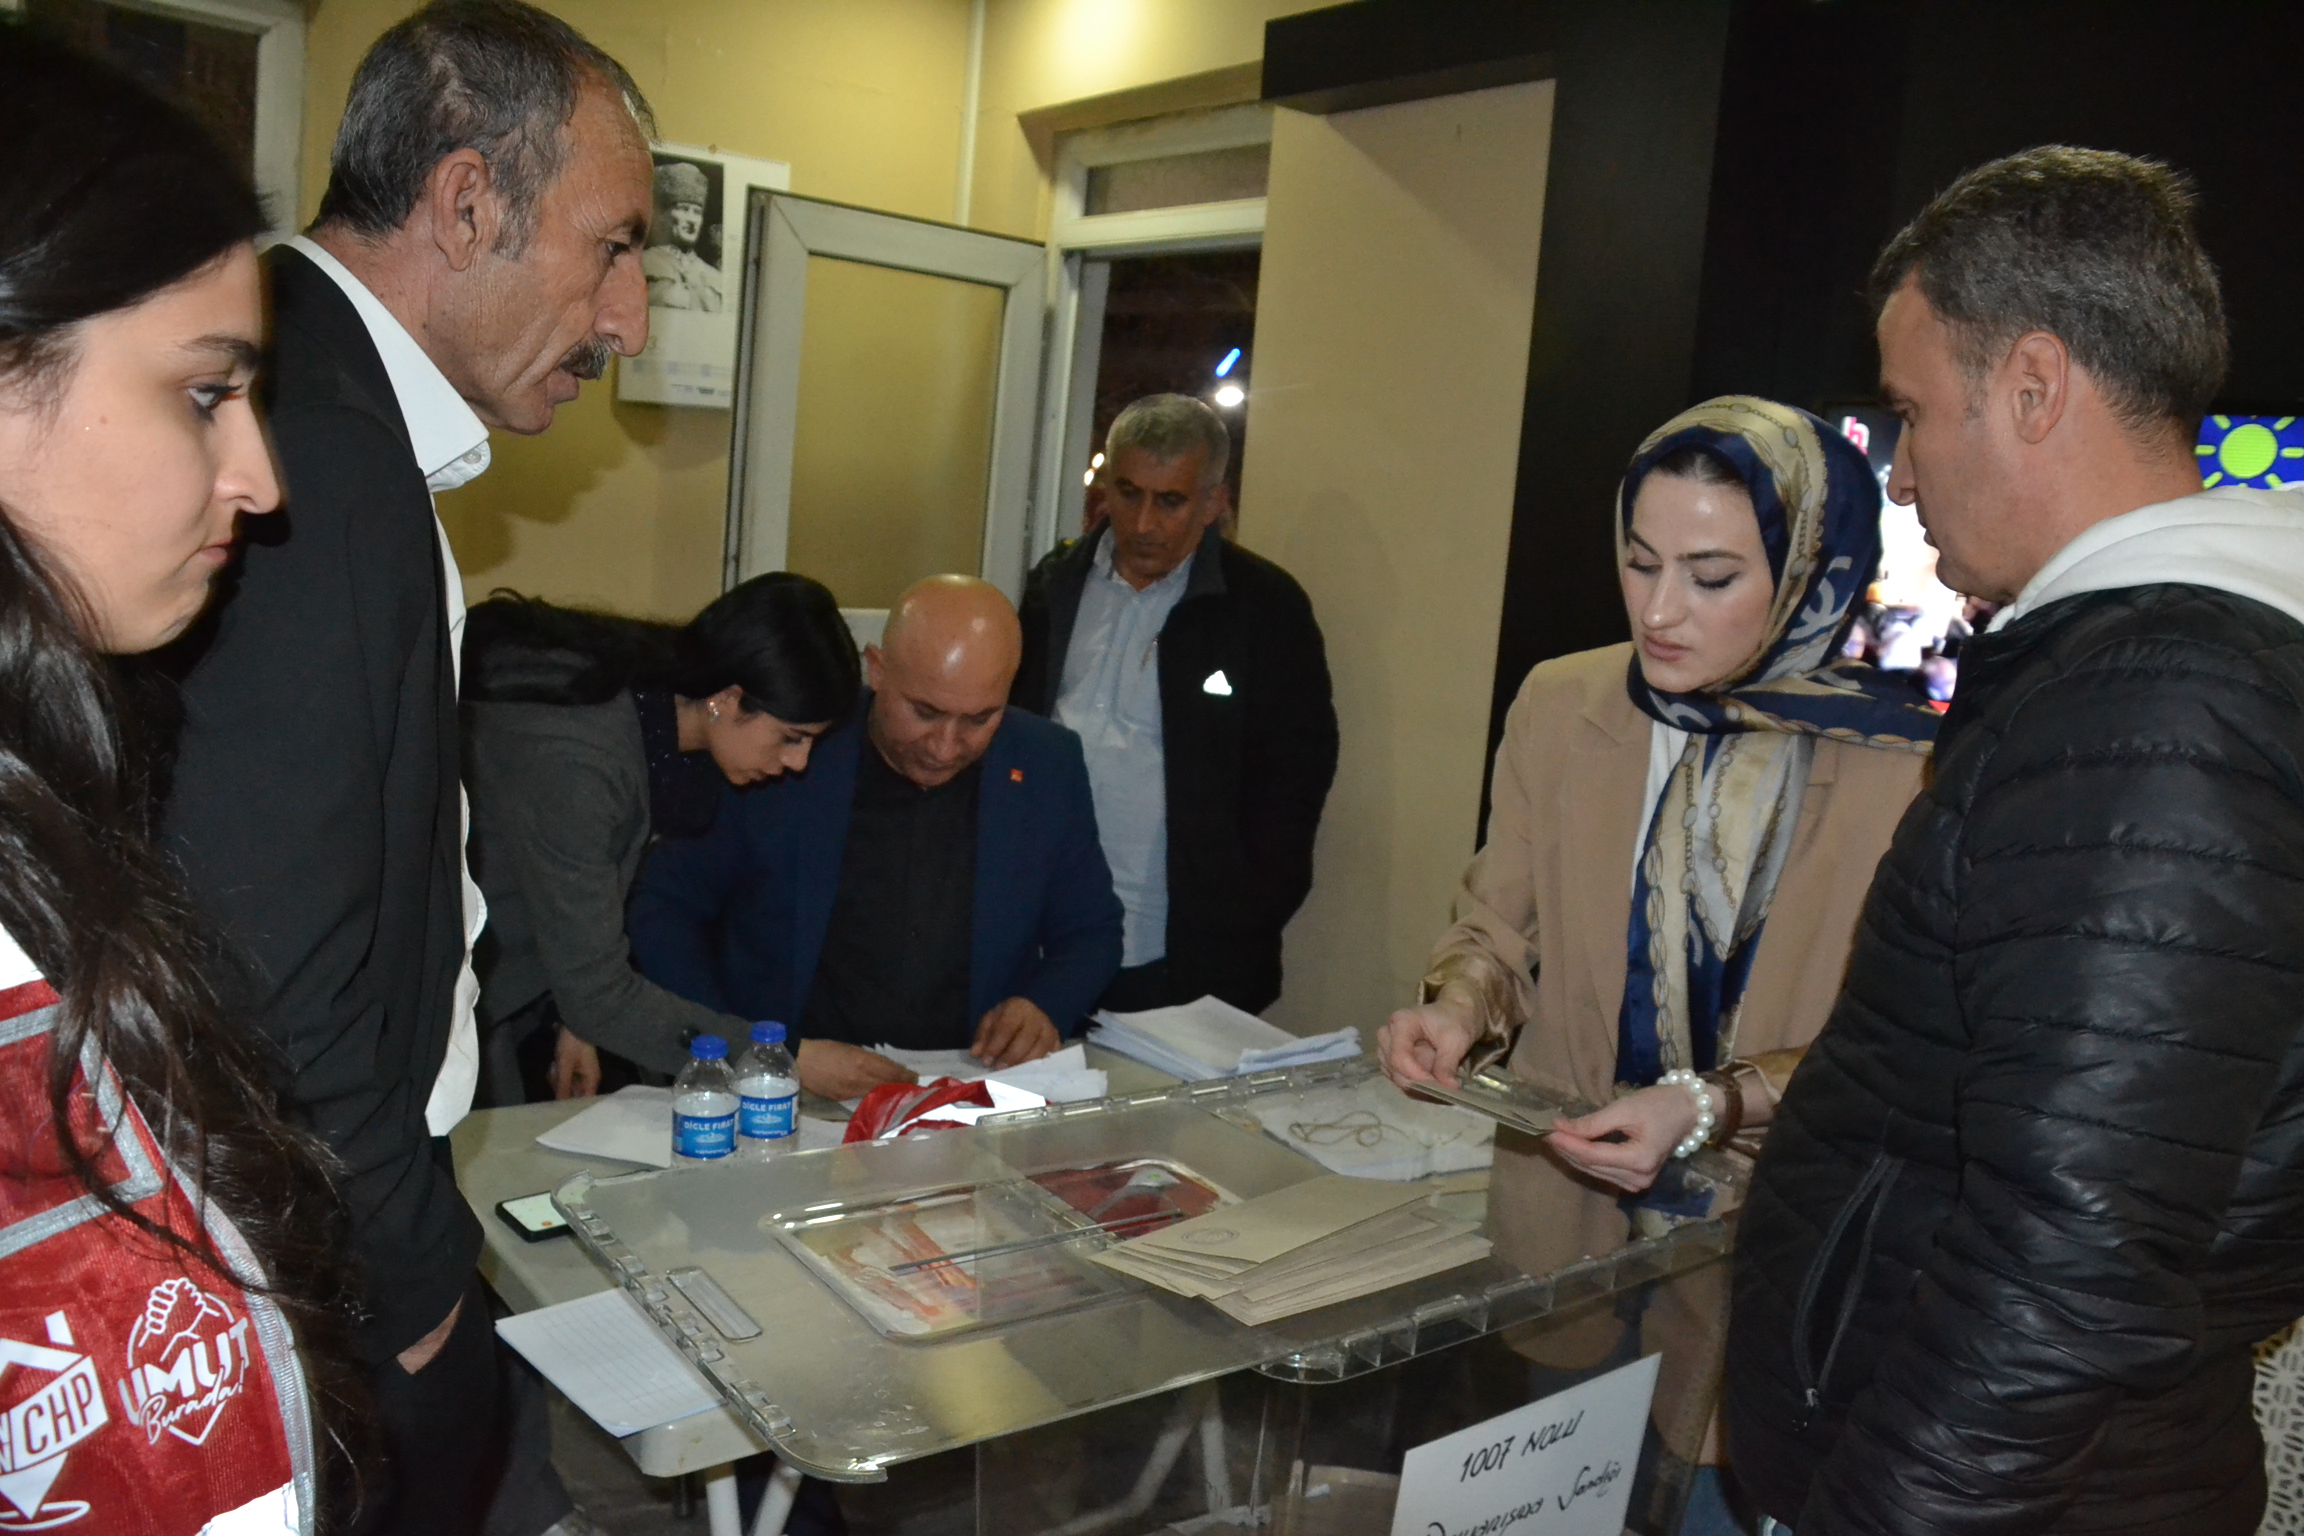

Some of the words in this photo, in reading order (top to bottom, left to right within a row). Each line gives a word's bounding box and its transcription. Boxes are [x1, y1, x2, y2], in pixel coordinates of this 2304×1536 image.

[684, 1119, 711, 1131] DİCLE
[712, 1118, 734, 1130] FIRAT
[768, 1101, 792, 1111] FIRAT
[118, 1317, 249, 1426] UMUT
[139, 1358, 245, 1445] Burada!
[24, 1372, 93, 1455] CHP
[1460, 1436, 1515, 1482] 1007
